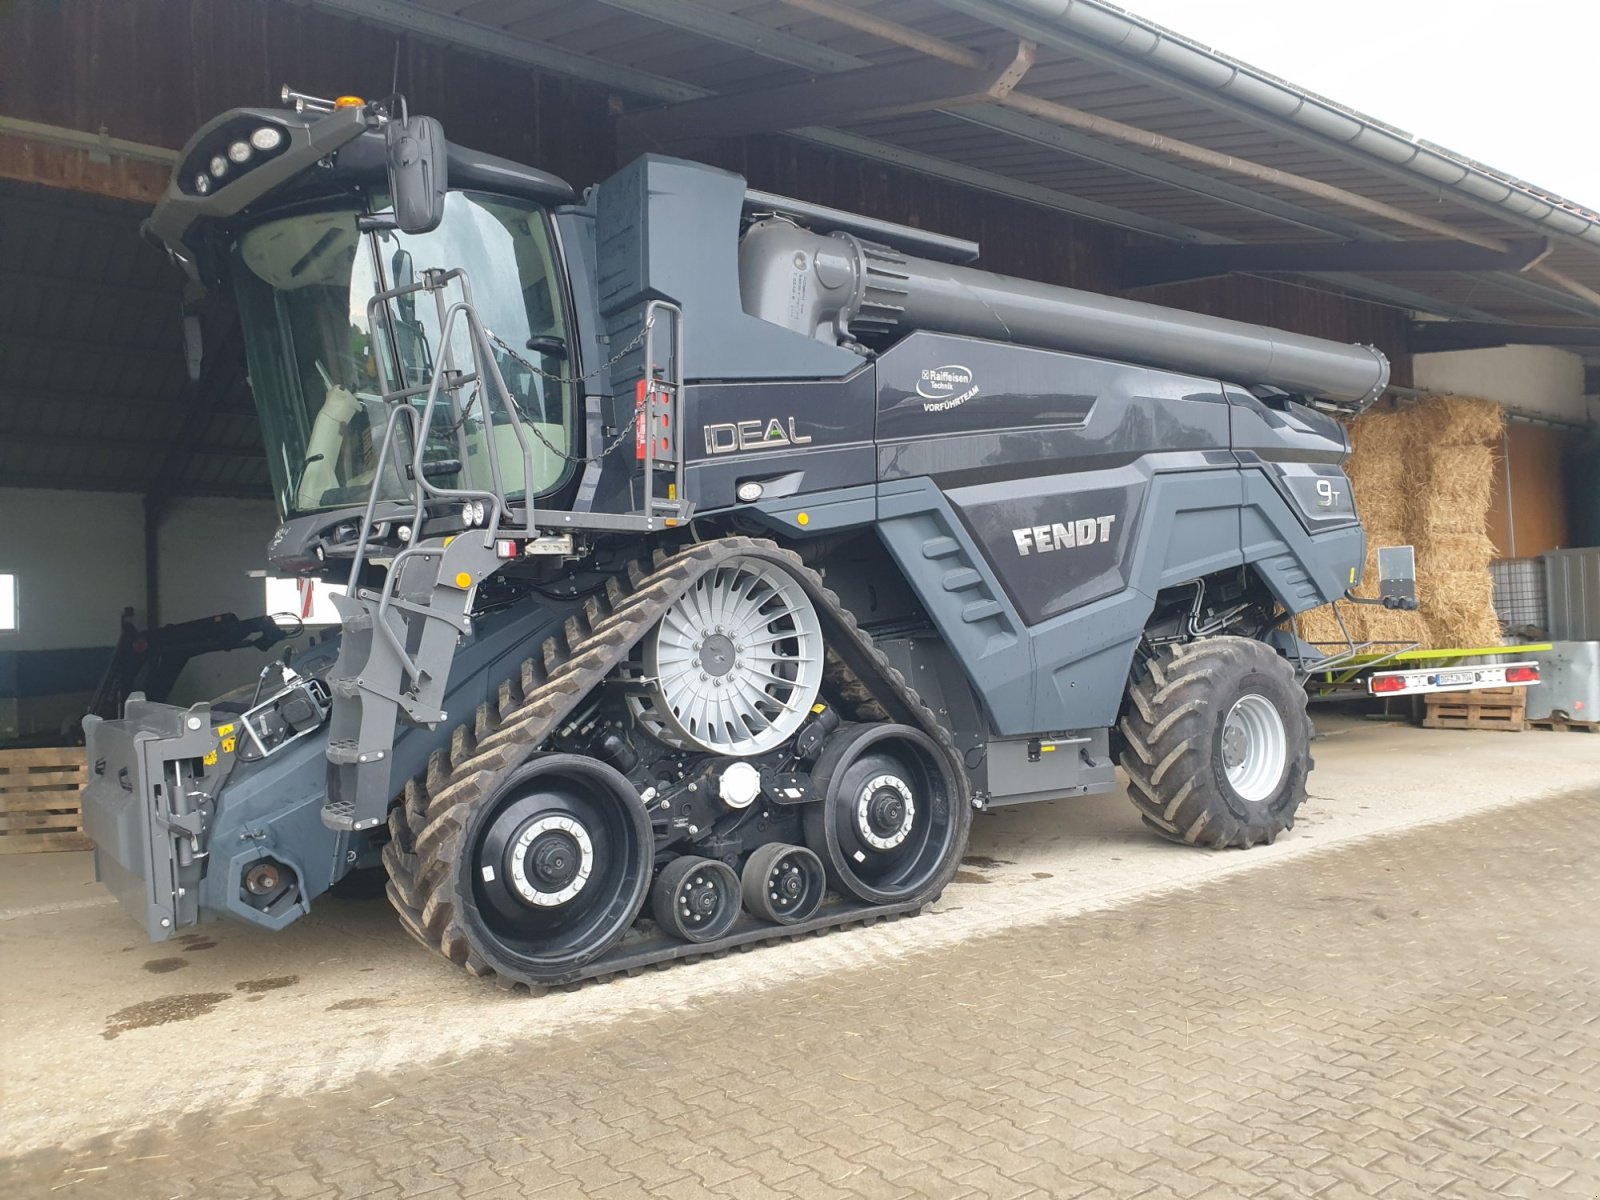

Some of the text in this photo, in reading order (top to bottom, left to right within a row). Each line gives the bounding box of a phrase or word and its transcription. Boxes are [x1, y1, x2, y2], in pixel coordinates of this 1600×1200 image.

[930, 370, 969, 384] Raiffeisen
[930, 381, 954, 391] Technik
[923, 384, 980, 412] VORFÜHRTEAM
[703, 416, 812, 455] IDEAL
[1012, 514, 1116, 557] FENDT
